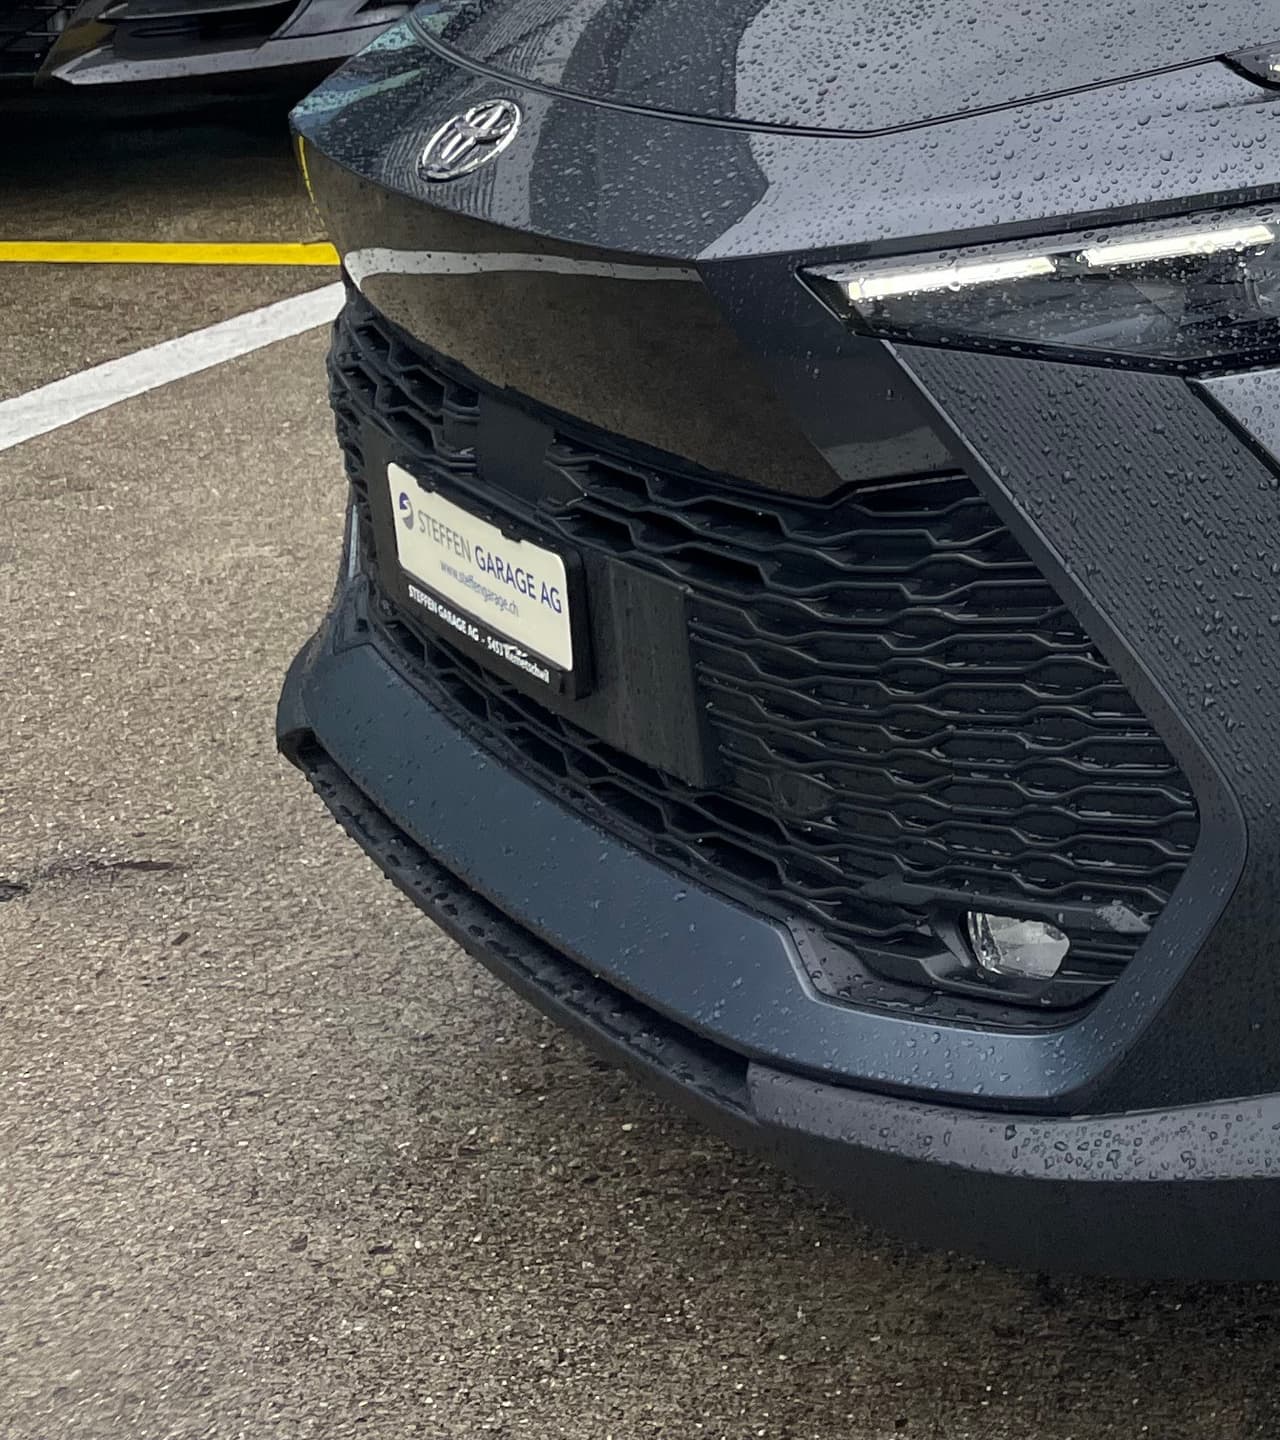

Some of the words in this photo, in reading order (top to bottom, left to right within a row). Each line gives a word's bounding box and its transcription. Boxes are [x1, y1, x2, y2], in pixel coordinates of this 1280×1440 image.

[418, 511, 472, 563] STEFFEN
[475, 546, 536, 600] GARAGE
[541, 581, 563, 613] AG
[440, 562, 519, 616] www.steffengarage.ch
[408, 584, 438, 613] STEFFEN
[438, 605, 466, 634] GARAGE
[468, 624, 479, 641] AG
